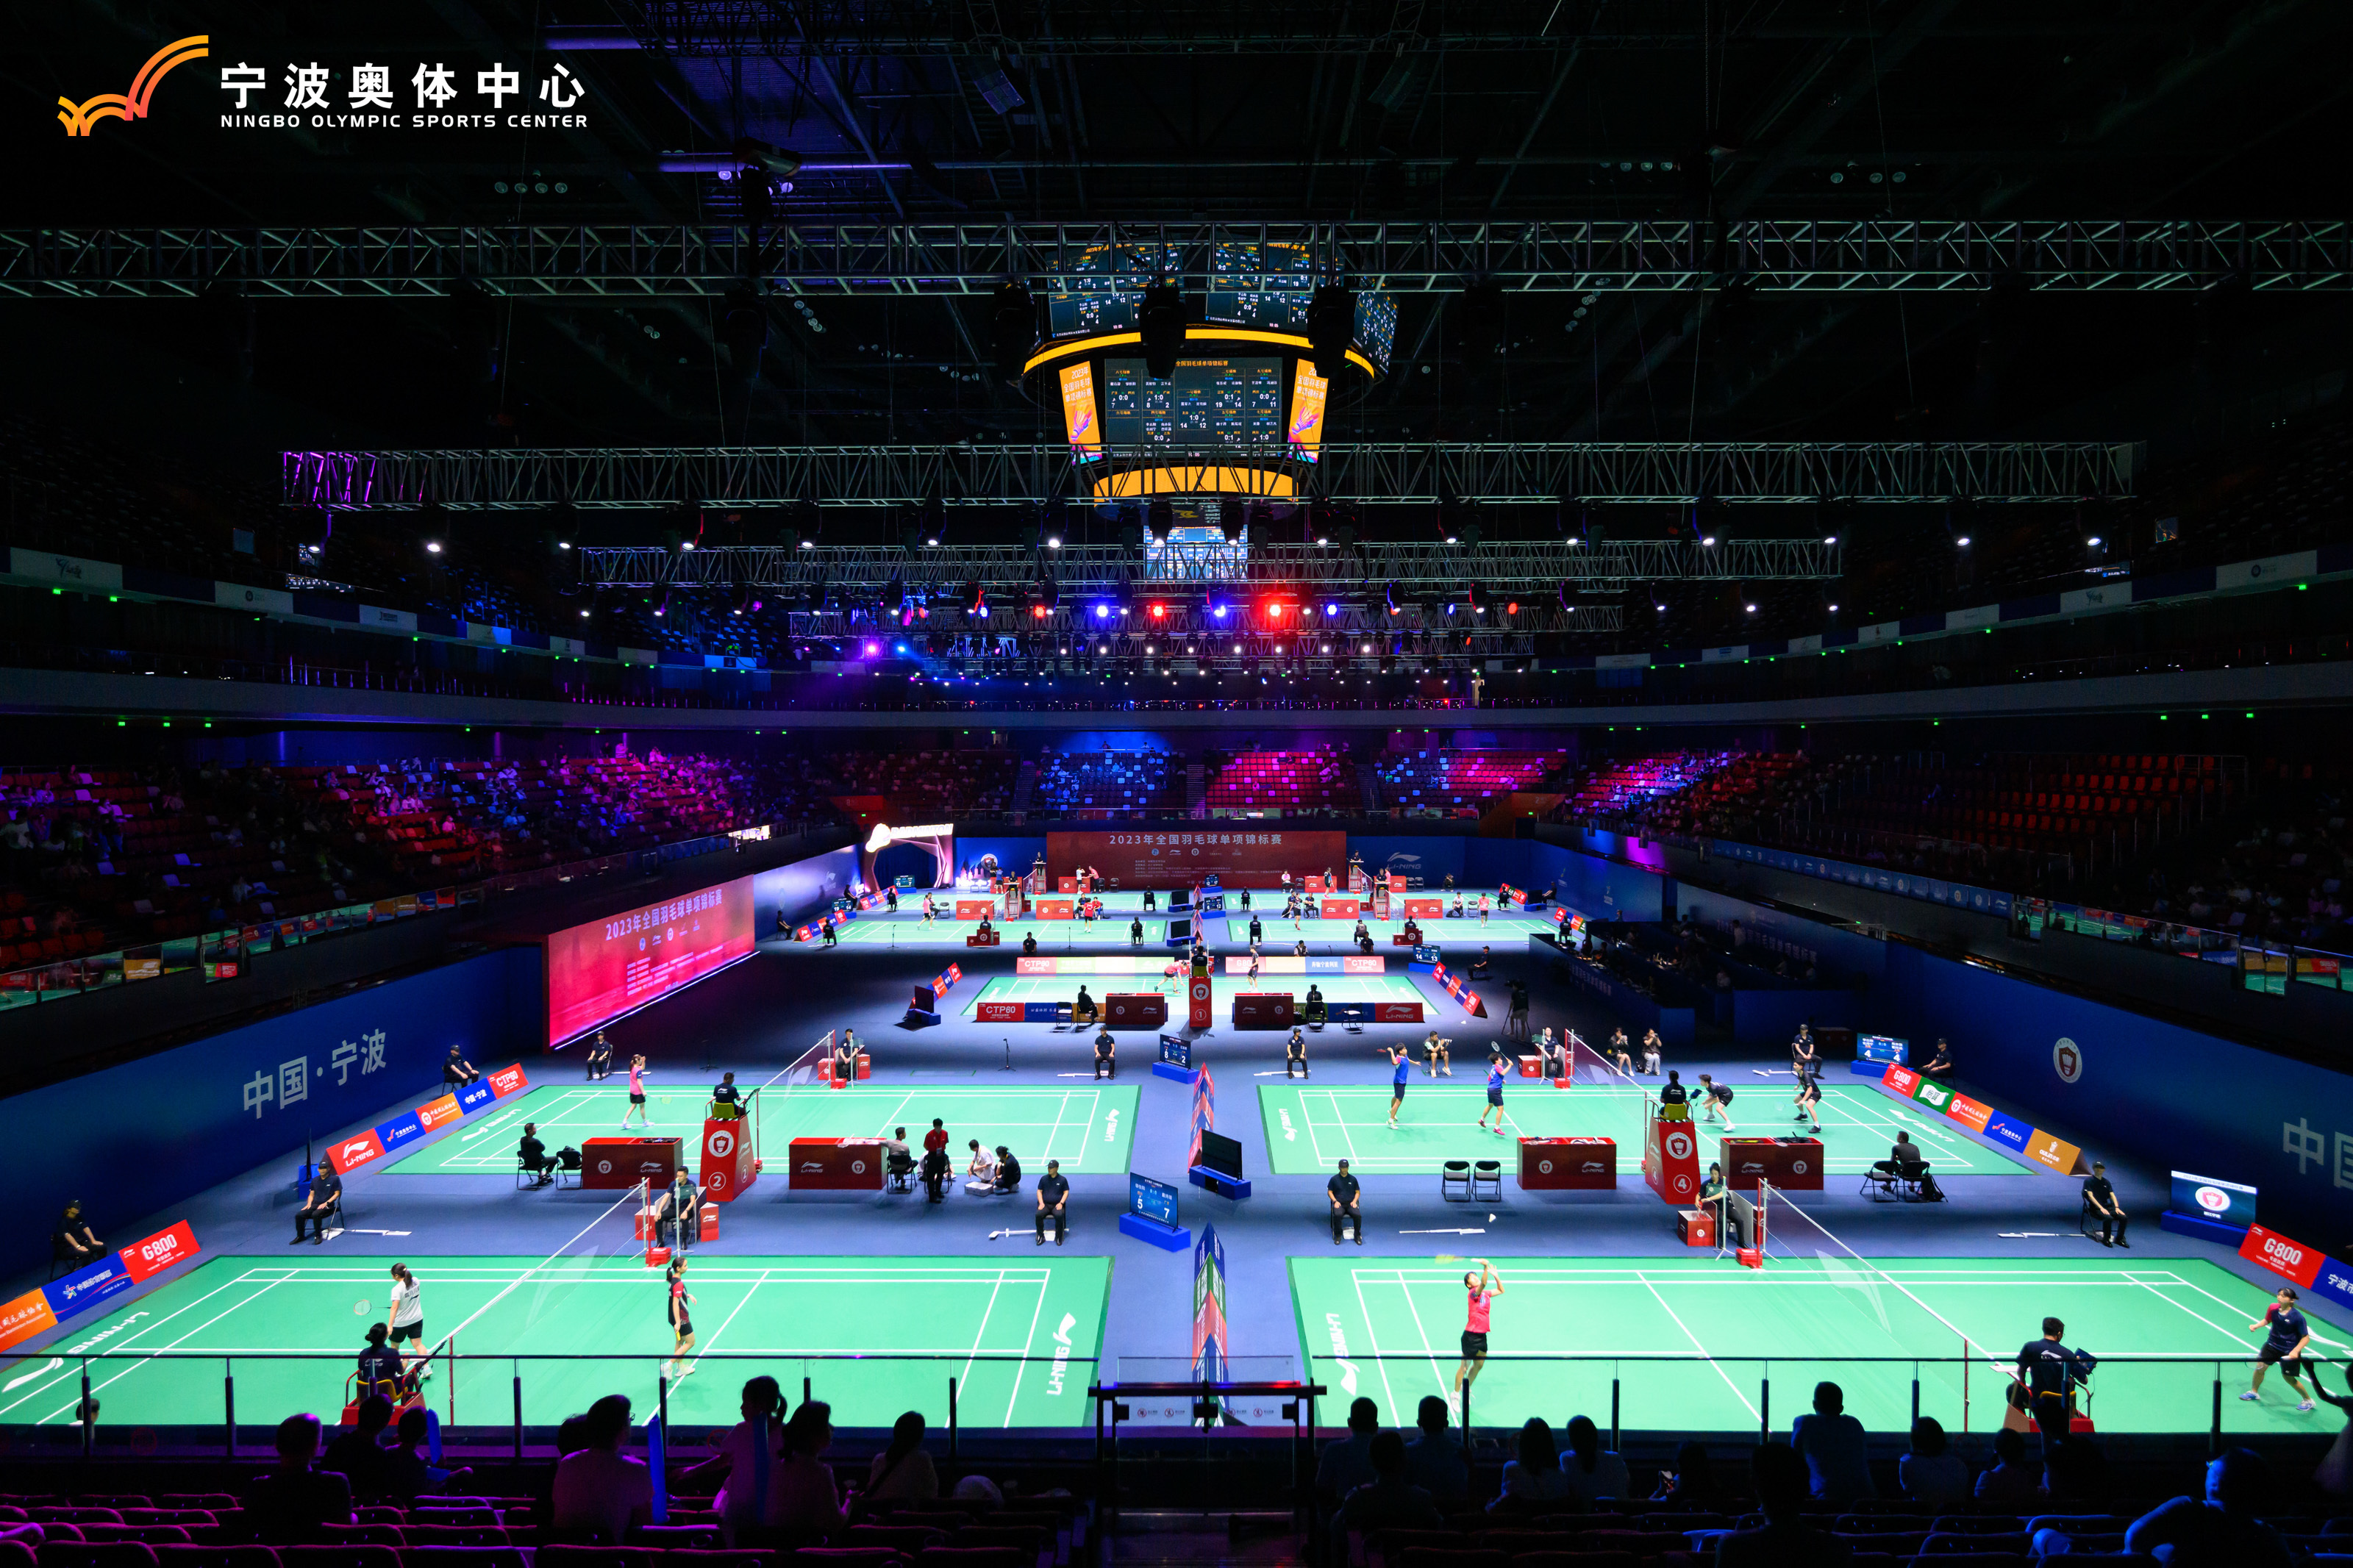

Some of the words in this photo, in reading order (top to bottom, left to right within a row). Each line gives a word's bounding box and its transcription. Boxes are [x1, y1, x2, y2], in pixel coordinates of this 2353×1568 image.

[1071, 366, 1089, 379] 2023年
[1063, 377, 1090, 393] 全国羽毛球
[890, 823, 954, 838] BADMINTON
[1110, 834, 1282, 845] 2023年全国羽毛球单项锦标赛
[606, 889, 722, 941] 2023年全国羽毛球单项锦标赛
[985, 1006, 1016, 1014] CTP60
[1164, 1050, 1168, 1059] 8
[1181, 1056, 1186, 1064] 2
[1864, 1050, 1872, 1058] 4
[1893, 1053, 1901, 1062] 4
[243, 1028, 386, 1119] 中国·宁波
[496, 1070, 518, 1087] CTP60
[1893, 1070, 1912, 1086] G800
[464, 1089, 488, 1105] 中国·宁波
[345, 1149, 375, 1167] LI-NING
[1137, 1198, 1143, 1209] 5
[1163, 1207, 1170, 1219] 7
[142, 1234, 178, 1261] G800
[2264, 1238, 2302, 1265] G800
[67, 1311, 150, 1354] LI-NING
[1326, 1313, 1349, 1357] LI-NING
[1046, 1345, 1071, 1396] LI-NING
